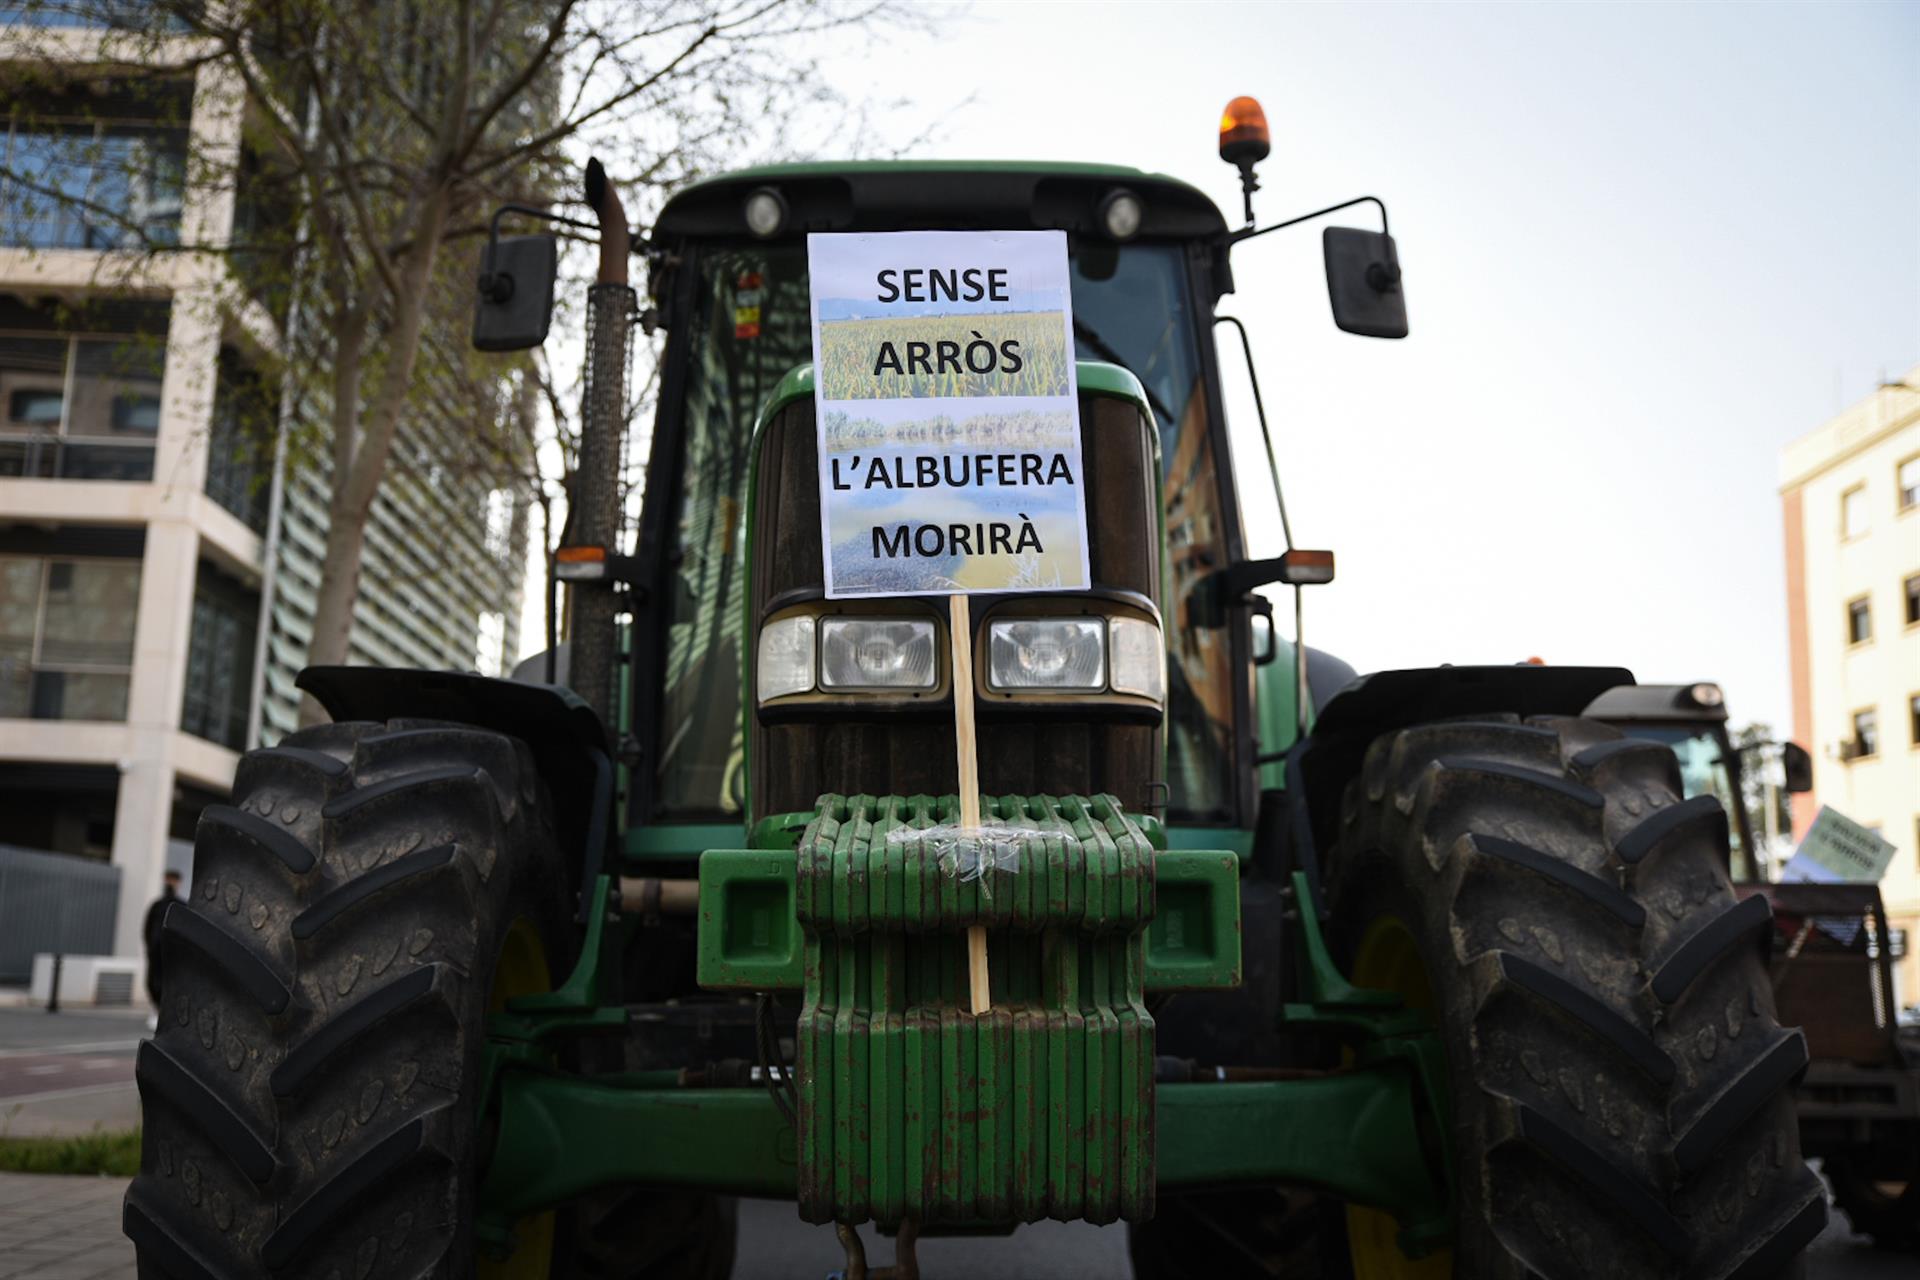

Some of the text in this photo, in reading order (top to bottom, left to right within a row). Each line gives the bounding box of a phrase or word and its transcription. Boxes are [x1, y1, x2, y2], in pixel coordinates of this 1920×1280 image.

[877, 268, 1010, 303] SENSE
[873, 330, 1023, 376] ARRÒS
[831, 453, 1074, 490] L’ALBUFERA
[871, 513, 1044, 559] MORIRÀ
